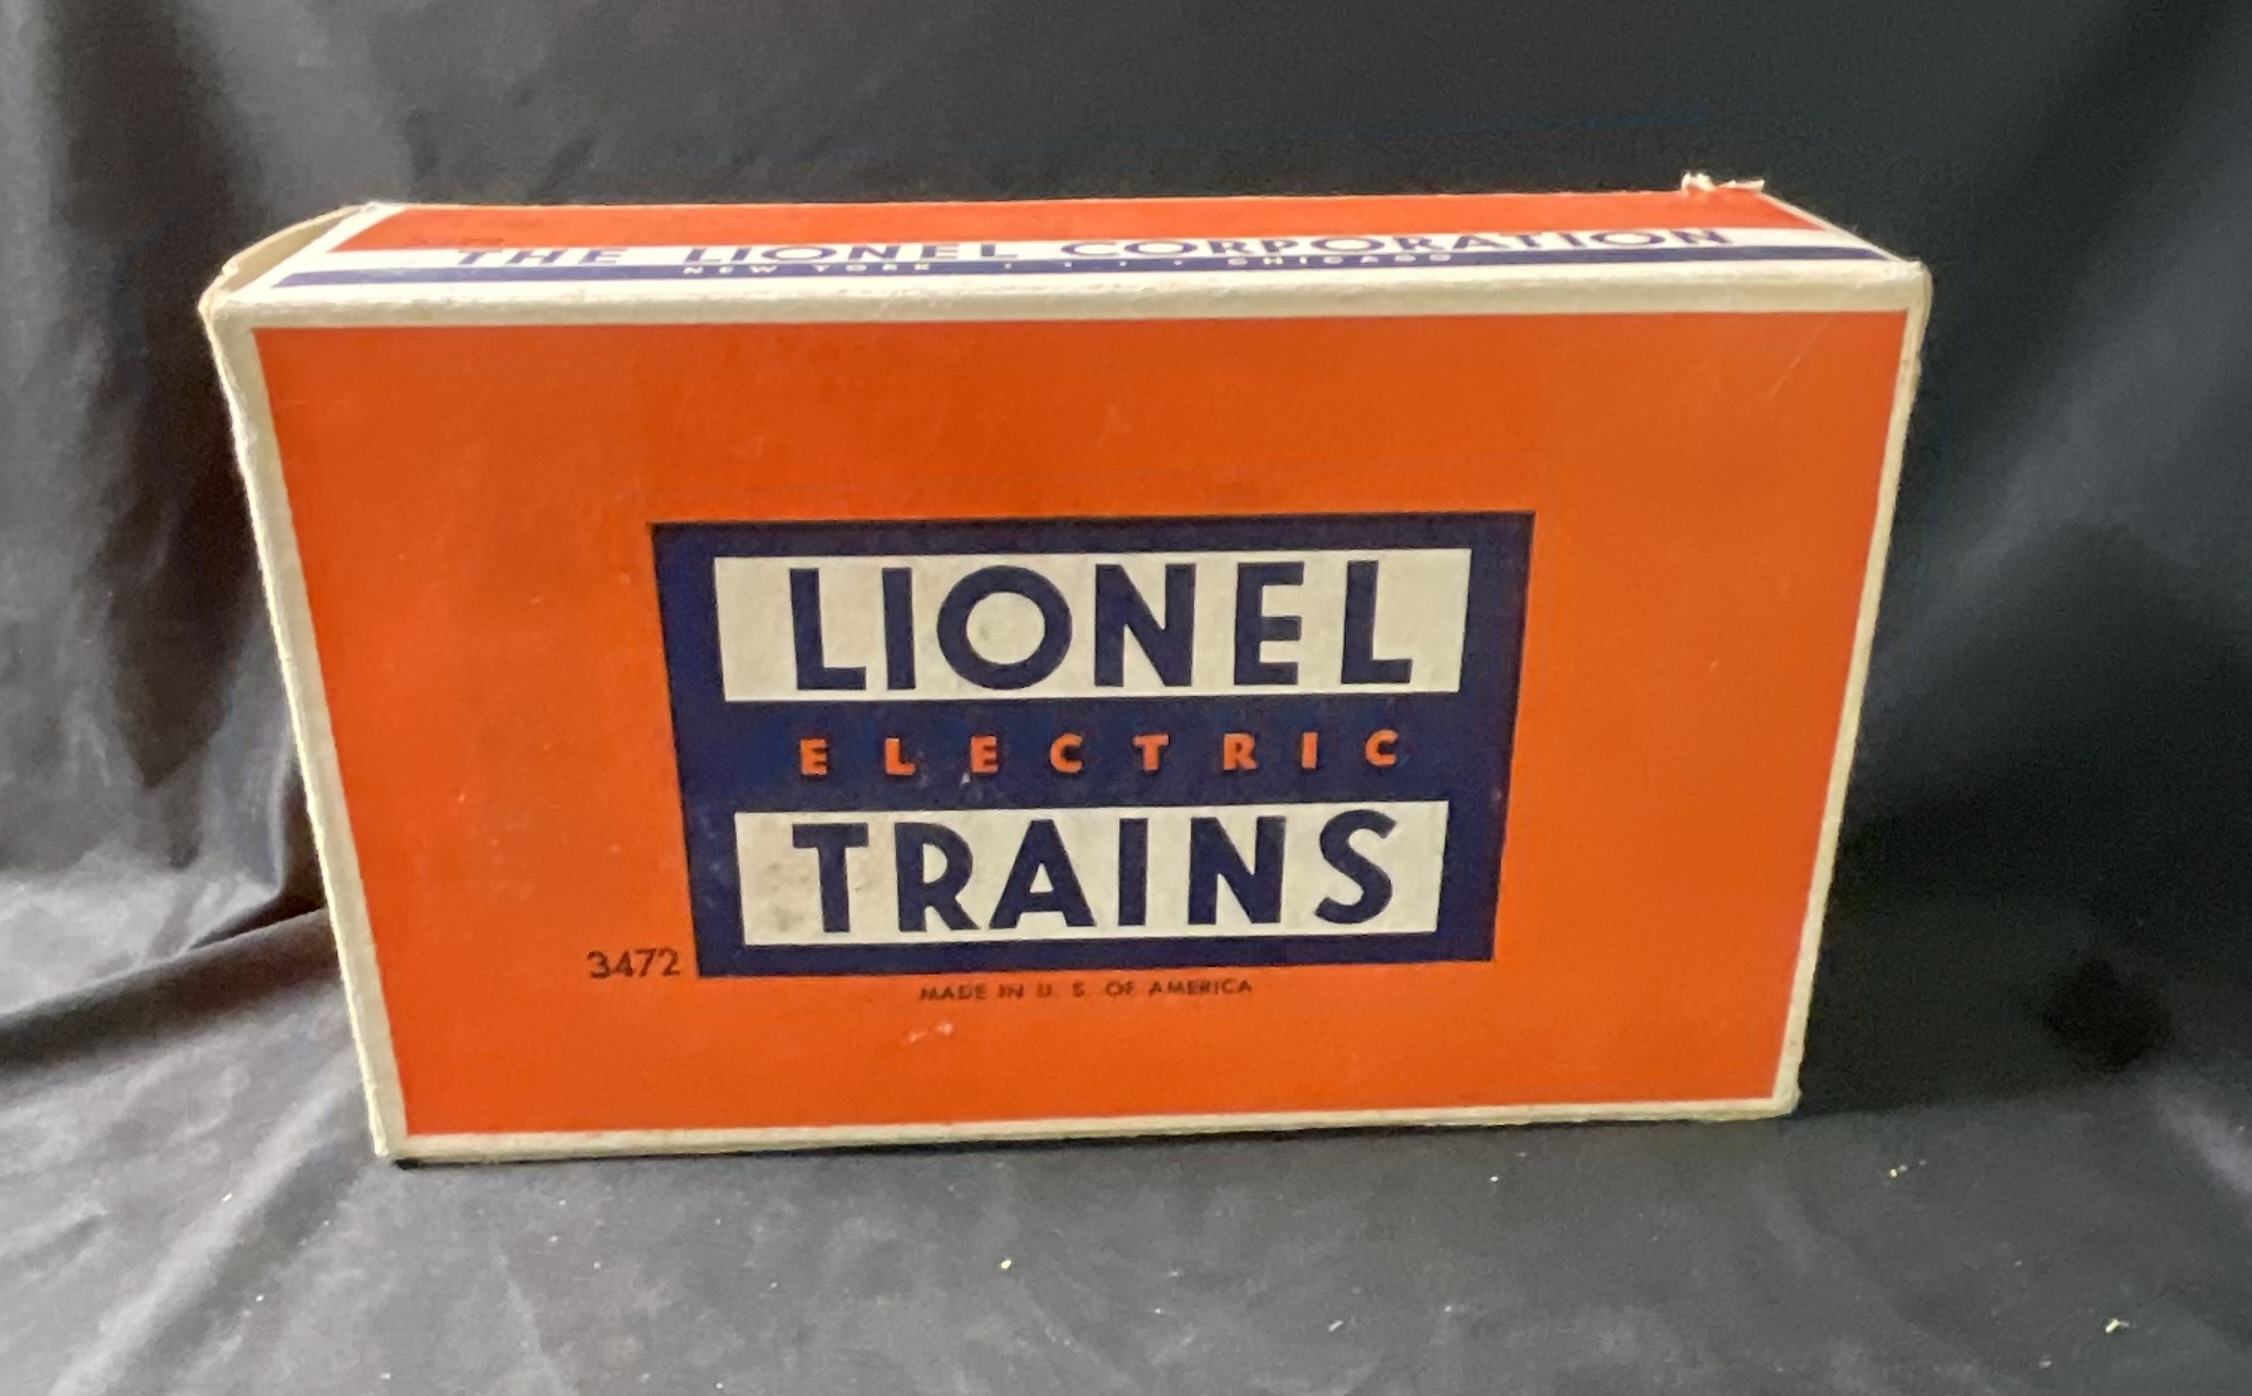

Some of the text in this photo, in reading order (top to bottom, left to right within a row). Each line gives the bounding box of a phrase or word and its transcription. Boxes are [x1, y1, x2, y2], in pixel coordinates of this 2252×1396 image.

[458, 230, 1734, 265] THE LIONEL CORPORATION
[683, 253, 1452, 275] NEW YORK CHICAGO
[789, 559, 1413, 692] LIONEL
[800, 728, 1401, 777] ELECTRIC
[792, 810, 1396, 934] TRAINS
[587, 948, 681, 979] 3472
[918, 983, 988, 1001] MADE
[998, 983, 1025, 999] IN
[1105, 980, 1135, 996] OF
[1149, 977, 1253, 996] AMERICA
